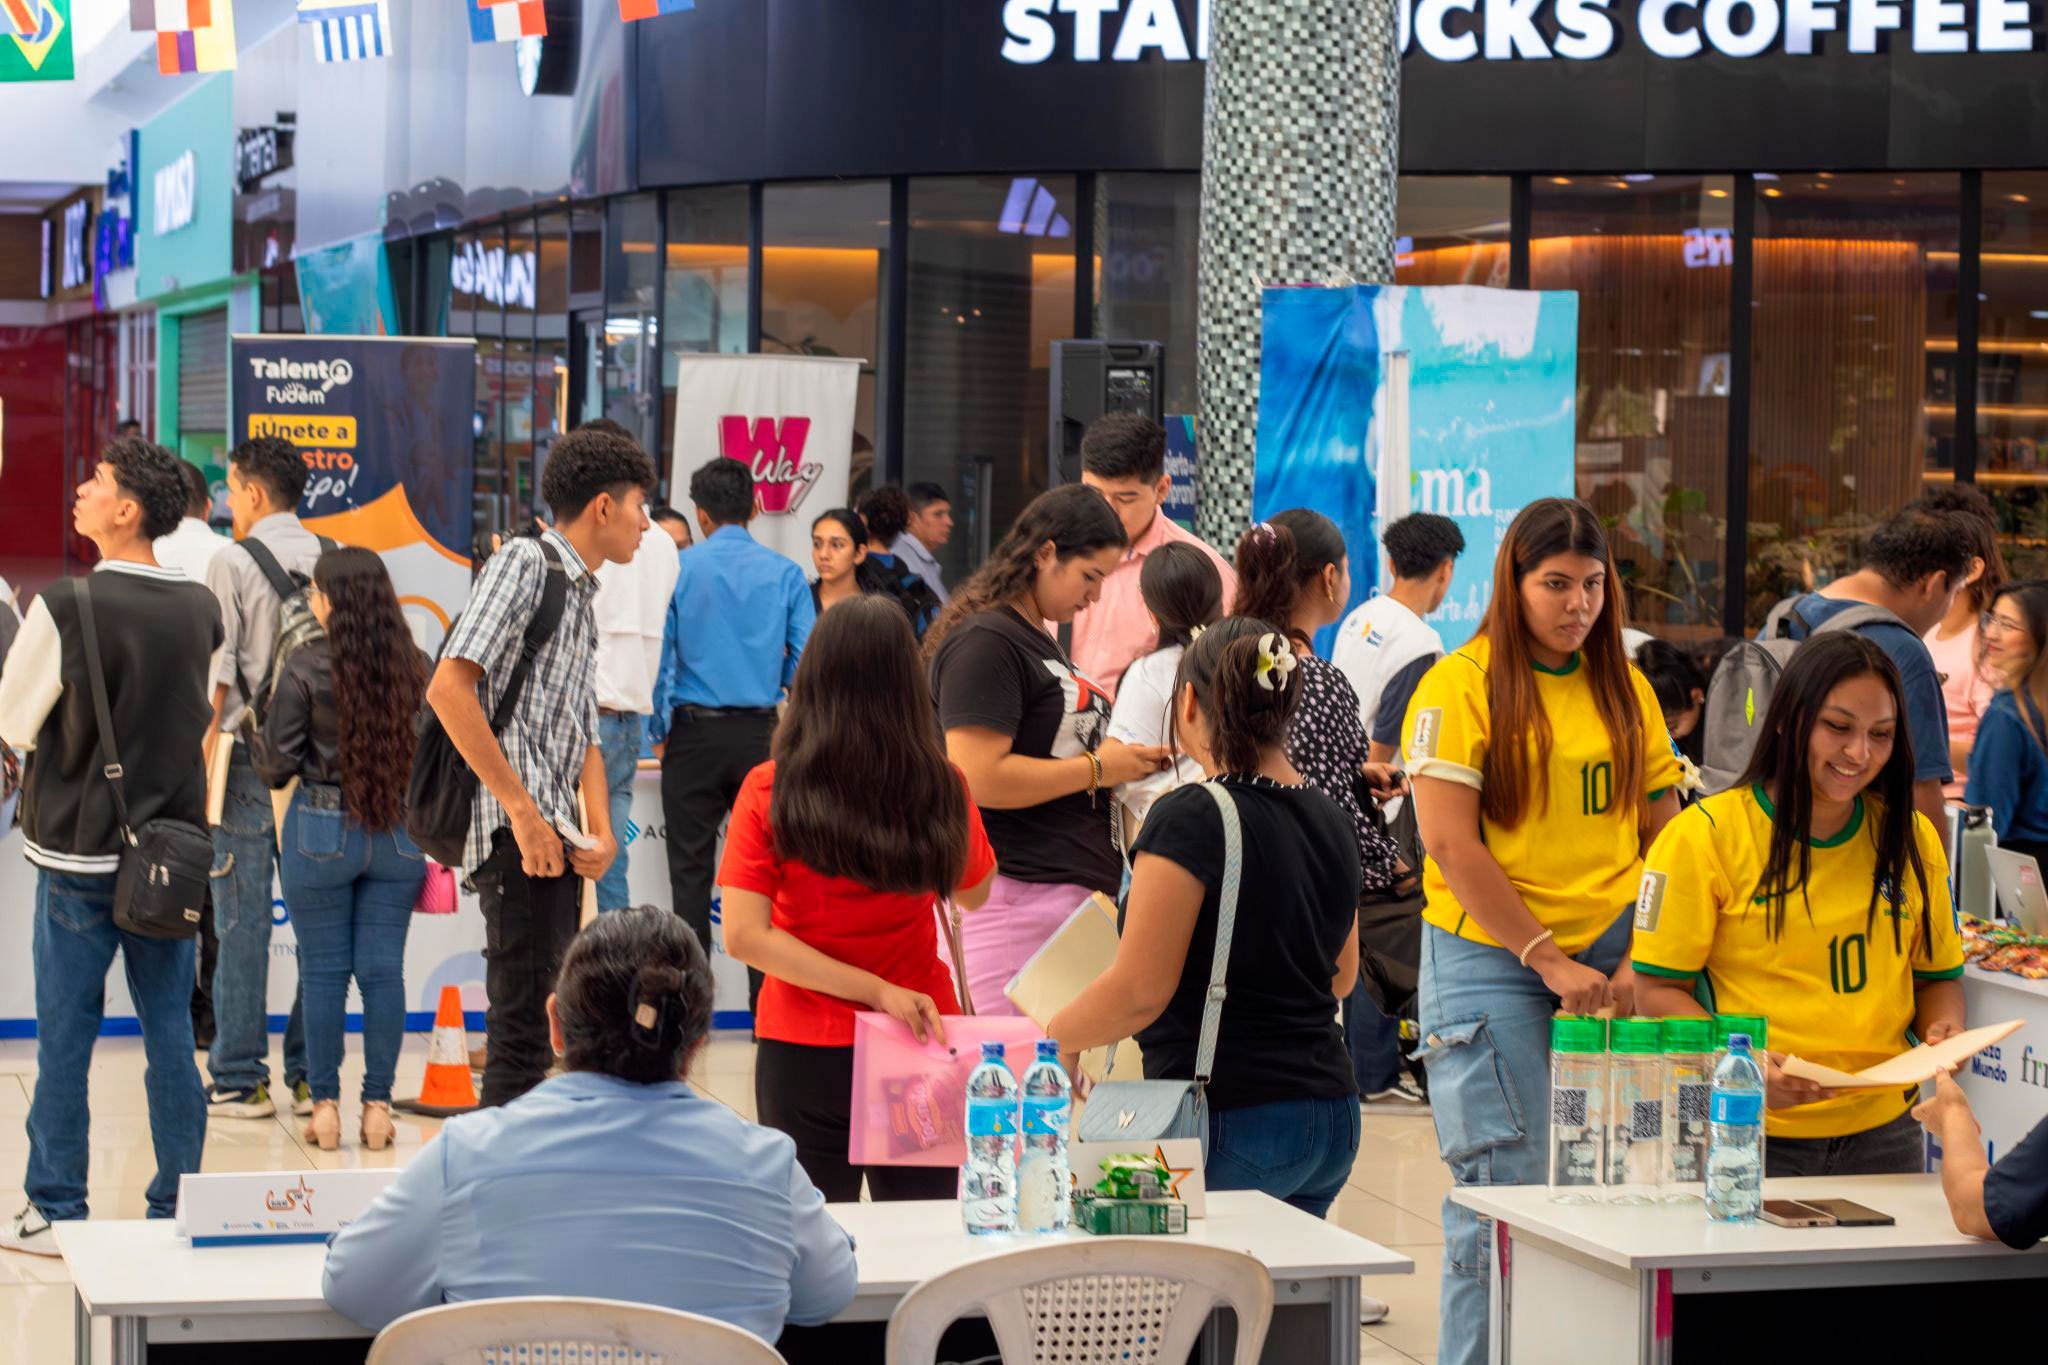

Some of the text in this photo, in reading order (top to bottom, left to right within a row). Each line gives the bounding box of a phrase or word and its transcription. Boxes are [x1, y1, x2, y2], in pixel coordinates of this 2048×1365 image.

[1001, 0, 2033, 64] STACKS COFFEE
[336, 426, 349, 440] a
[301, 448, 354, 470] stro
[752, 445, 824, 514] Way
[303, 463, 359, 510] ipo!
[1581, 761, 1612, 816] 10
[1828, 933, 1867, 994] 10
[1972, 1058, 2008, 1083] Mundo
